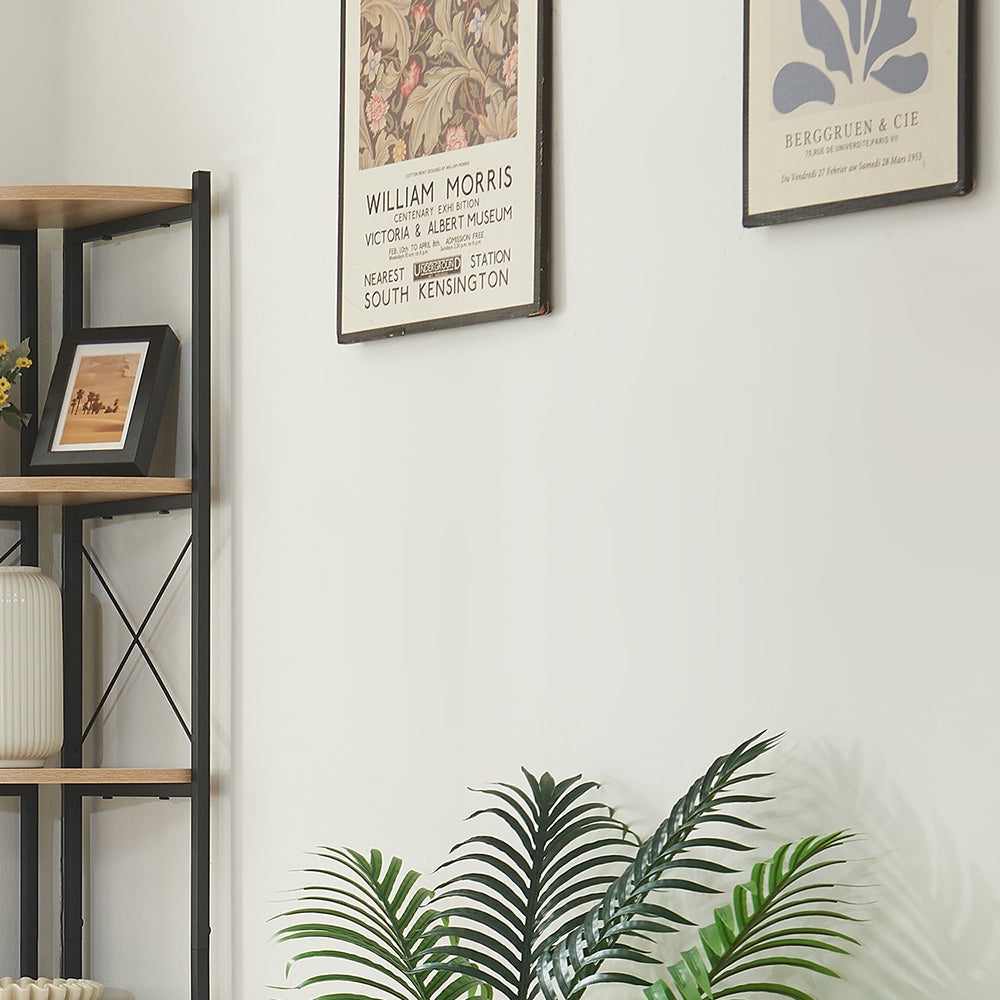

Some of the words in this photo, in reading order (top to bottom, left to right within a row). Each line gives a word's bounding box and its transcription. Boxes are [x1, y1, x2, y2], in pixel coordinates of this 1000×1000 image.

[785, 119, 873, 149] BERGGRUEN
[879, 118, 887, 132] &
[894, 111, 919, 129] CIE
[366, 181, 434, 216] WILLIAM
[446, 165, 513, 200] MORRIS
[365, 226, 410, 247] VICTORIA
[415, 224, 422, 238] &
[428, 215, 464, 236] ALBERT
[467, 206, 513, 227] MUSEUM
[394, 206, 434, 224] CENTENARY
[438, 198, 480, 214] EXHIBITION
[364, 268, 405, 287] NEAREST
[470, 248, 512, 269] STATION
[364, 286, 409, 310] SOUTH
[418, 268, 510, 300] KENSINGTON
